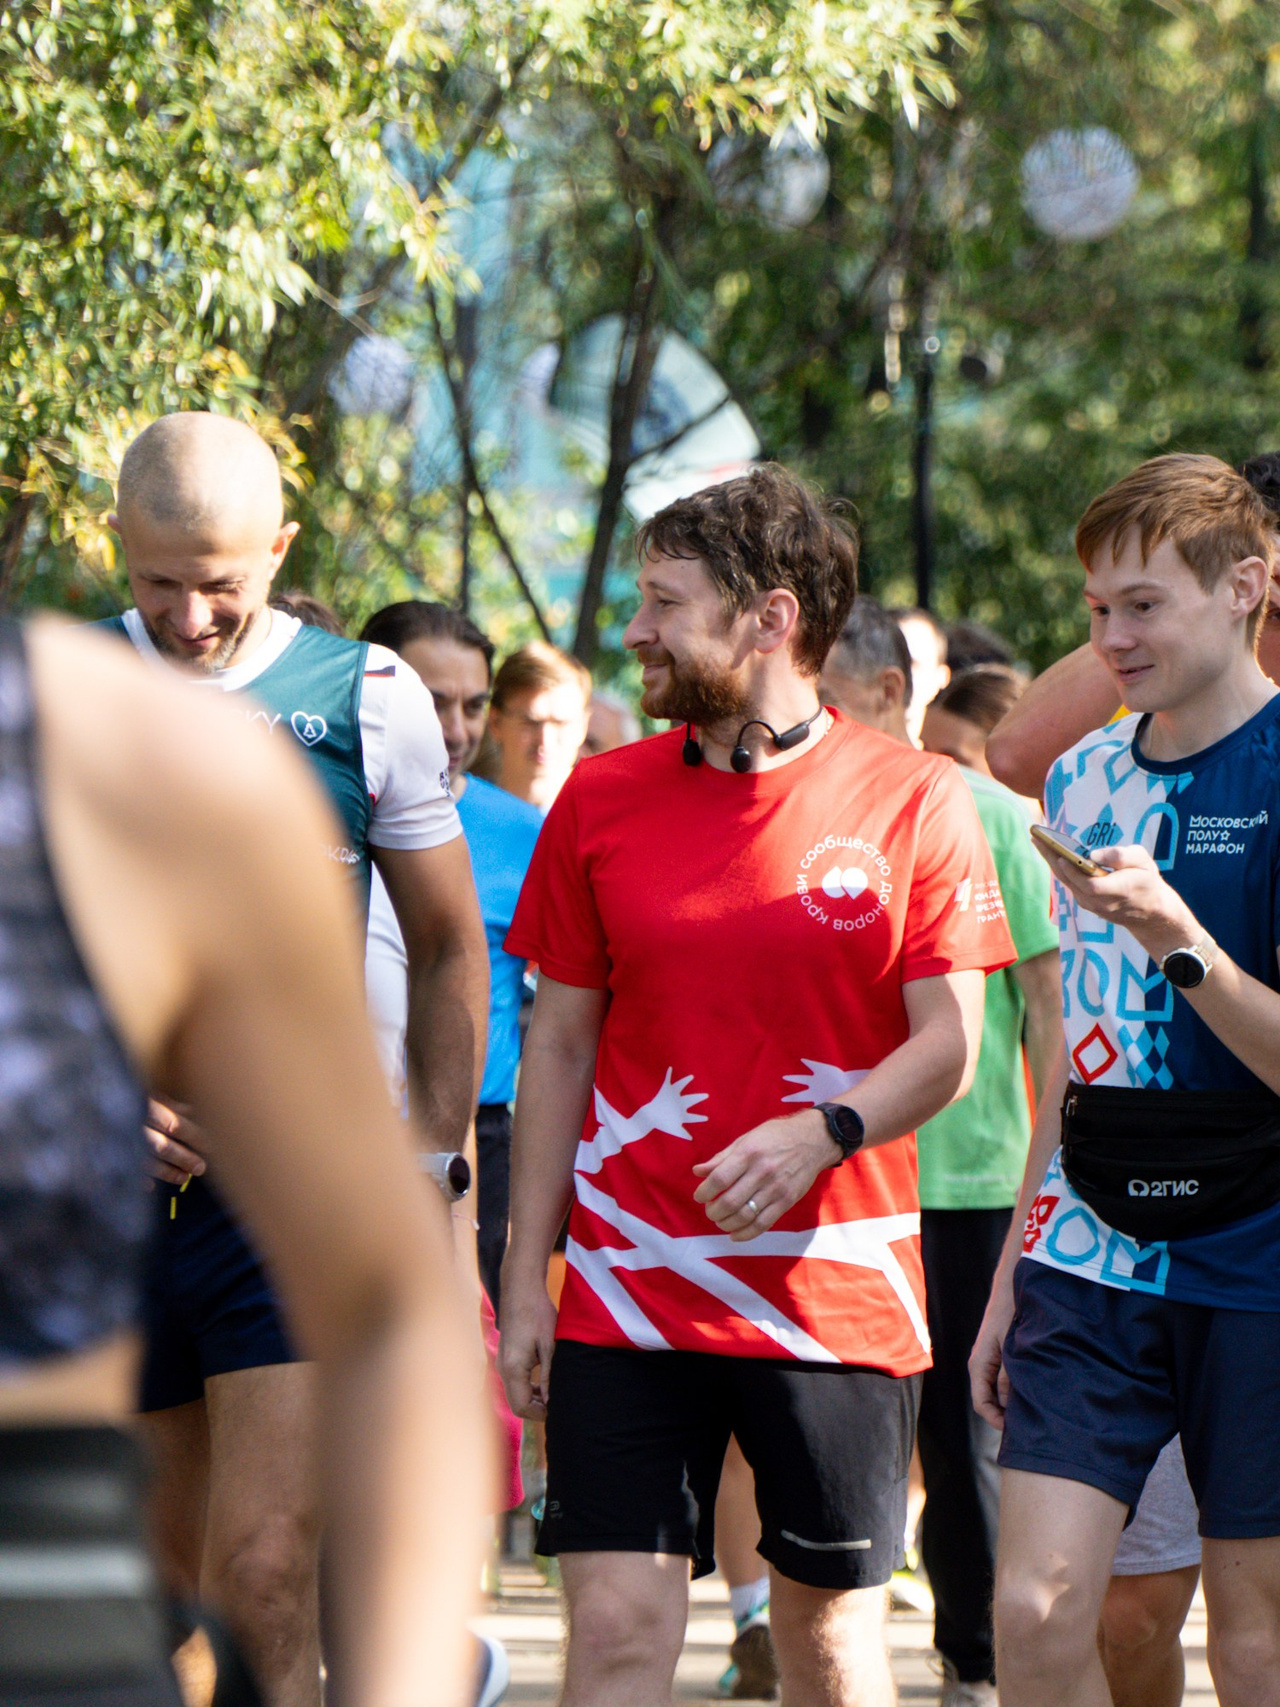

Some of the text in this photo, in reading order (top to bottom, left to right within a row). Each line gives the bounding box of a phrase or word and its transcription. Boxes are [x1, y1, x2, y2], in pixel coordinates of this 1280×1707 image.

[1187, 830, 1220, 841] ПОЛУ
[1185, 843, 1245, 855] МАРАФОН
[796, 834, 893, 931] сообщество доноров крови
[1150, 1179, 1200, 1197] 2ГИС
